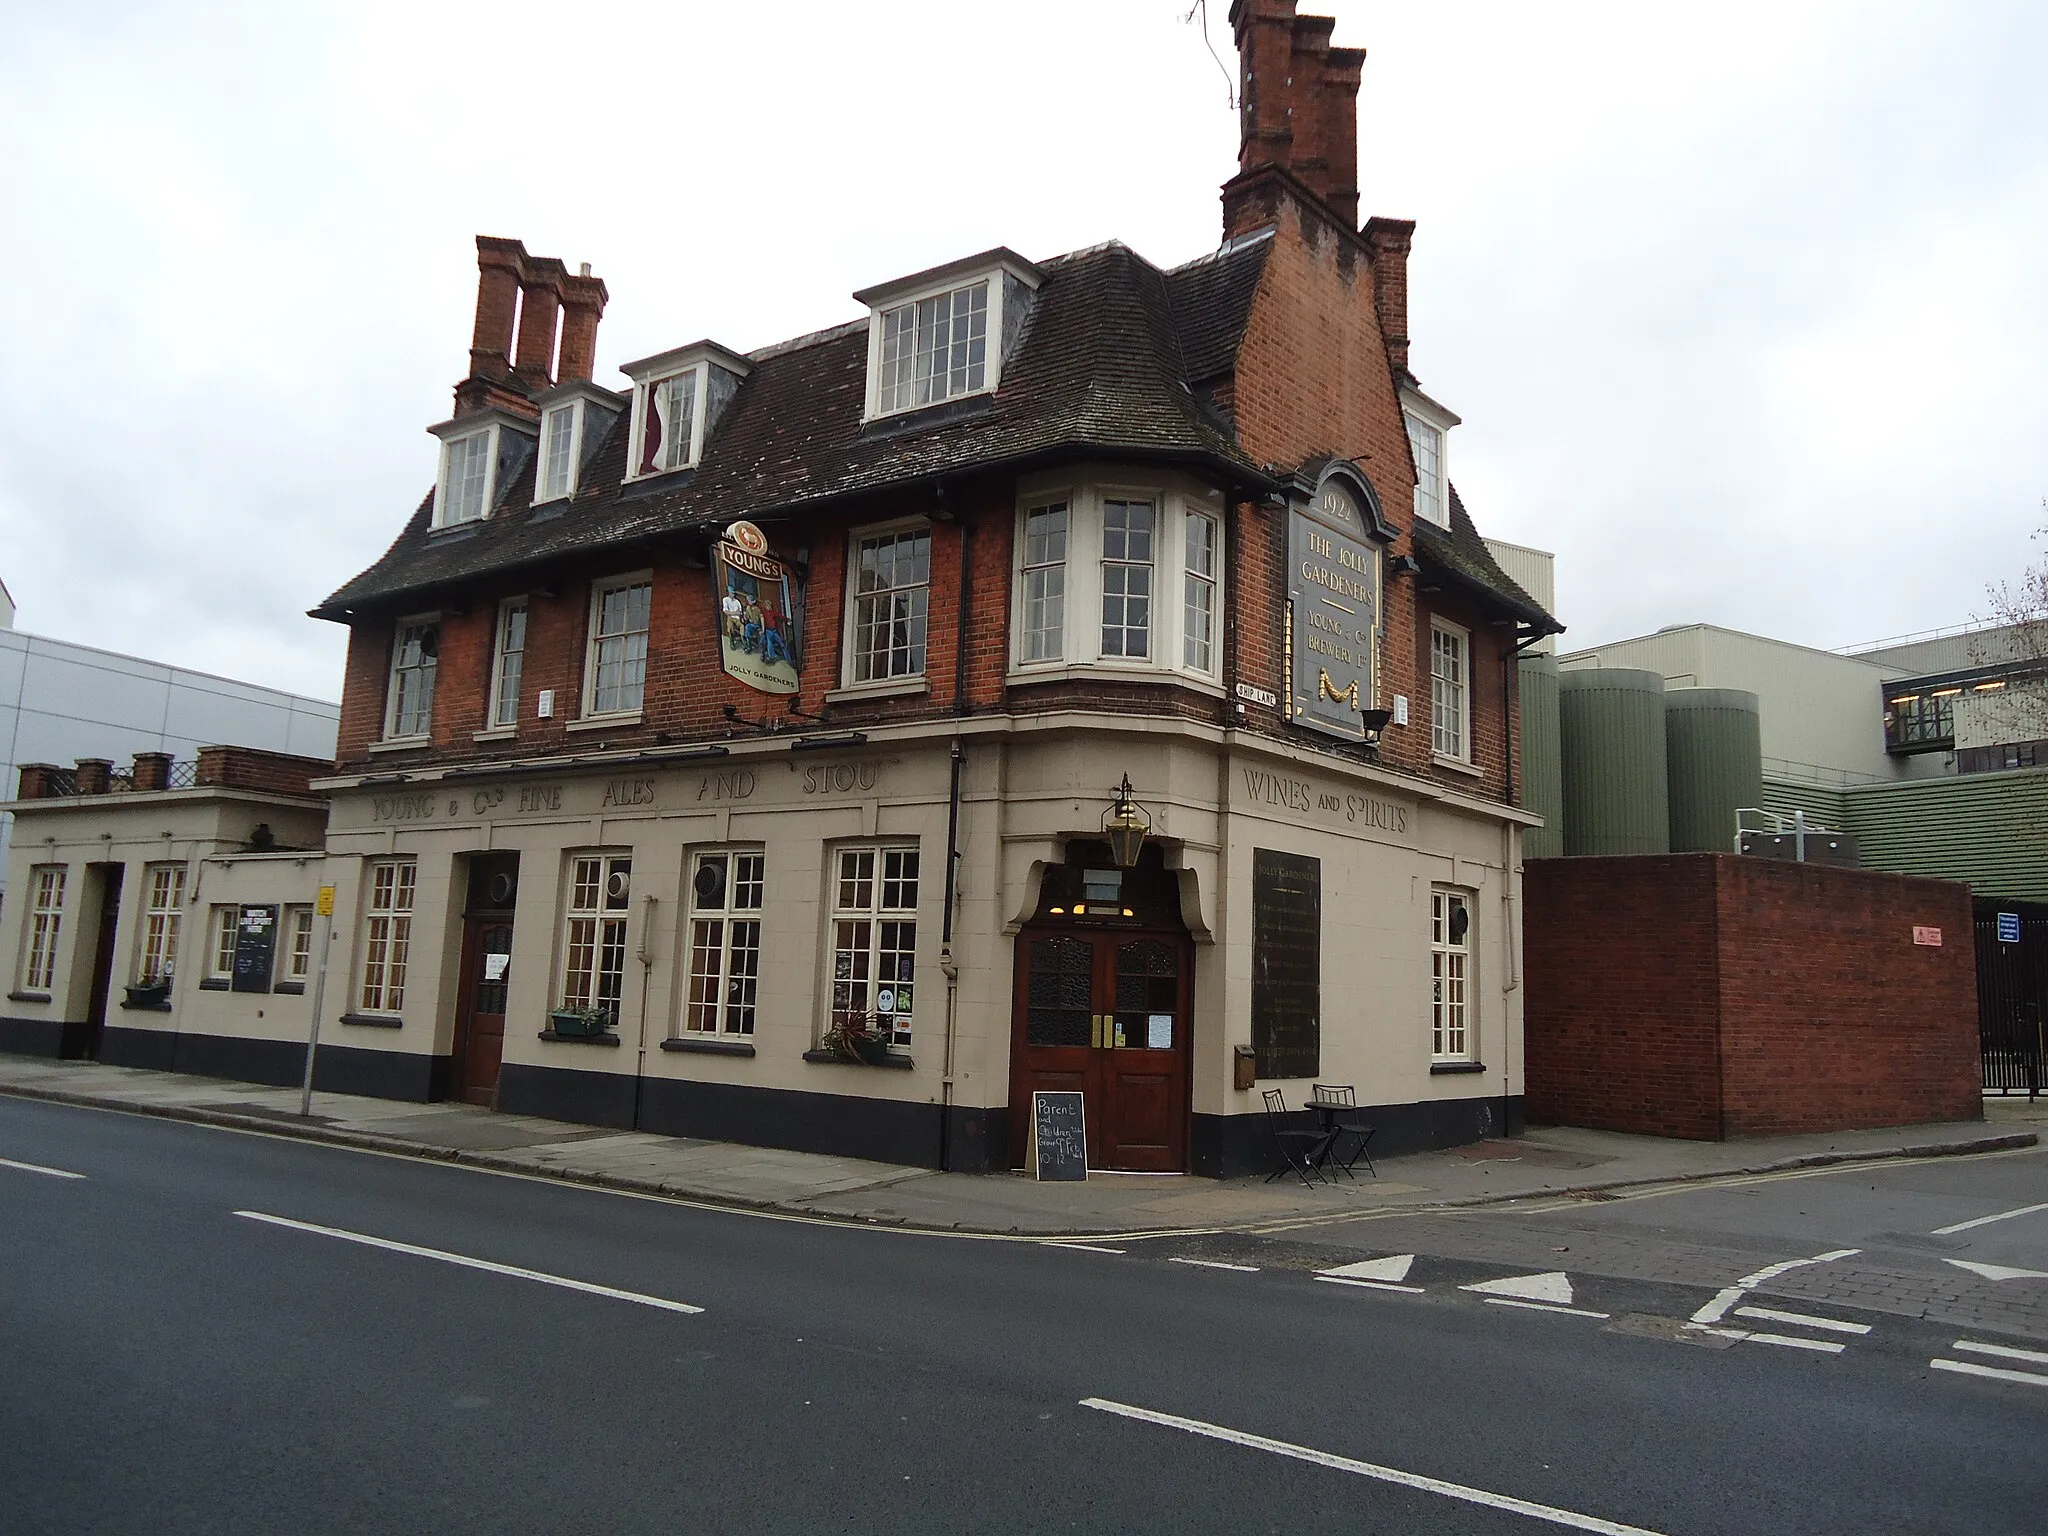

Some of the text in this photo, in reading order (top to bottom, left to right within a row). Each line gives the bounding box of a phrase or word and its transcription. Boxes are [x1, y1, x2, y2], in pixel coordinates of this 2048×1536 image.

[1323, 493, 1351, 521] 1922
[727, 547, 779, 577] YOUNG'S
[1307, 531, 1369, 576] THE JOLLY
[1302, 561, 1373, 608] GARDENERS
[1308, 610, 1342, 637] YOUNG
[1308, 634, 1352, 665] BREWERY
[729, 663, 795, 689] JOLLY GARDENERS
[1239, 685, 1274, 706] SHIP LANE
[372, 793, 434, 822] YOUNG
[518, 786, 562, 813] FINE
[602, 779, 655, 807] ALES
[1244, 768, 1408, 834] WINES AND SPIRITS
[1037, 1098, 1076, 1116] Parent
[1038, 1115, 1051, 1124] and
[1038, 1124, 1072, 1138] Children
